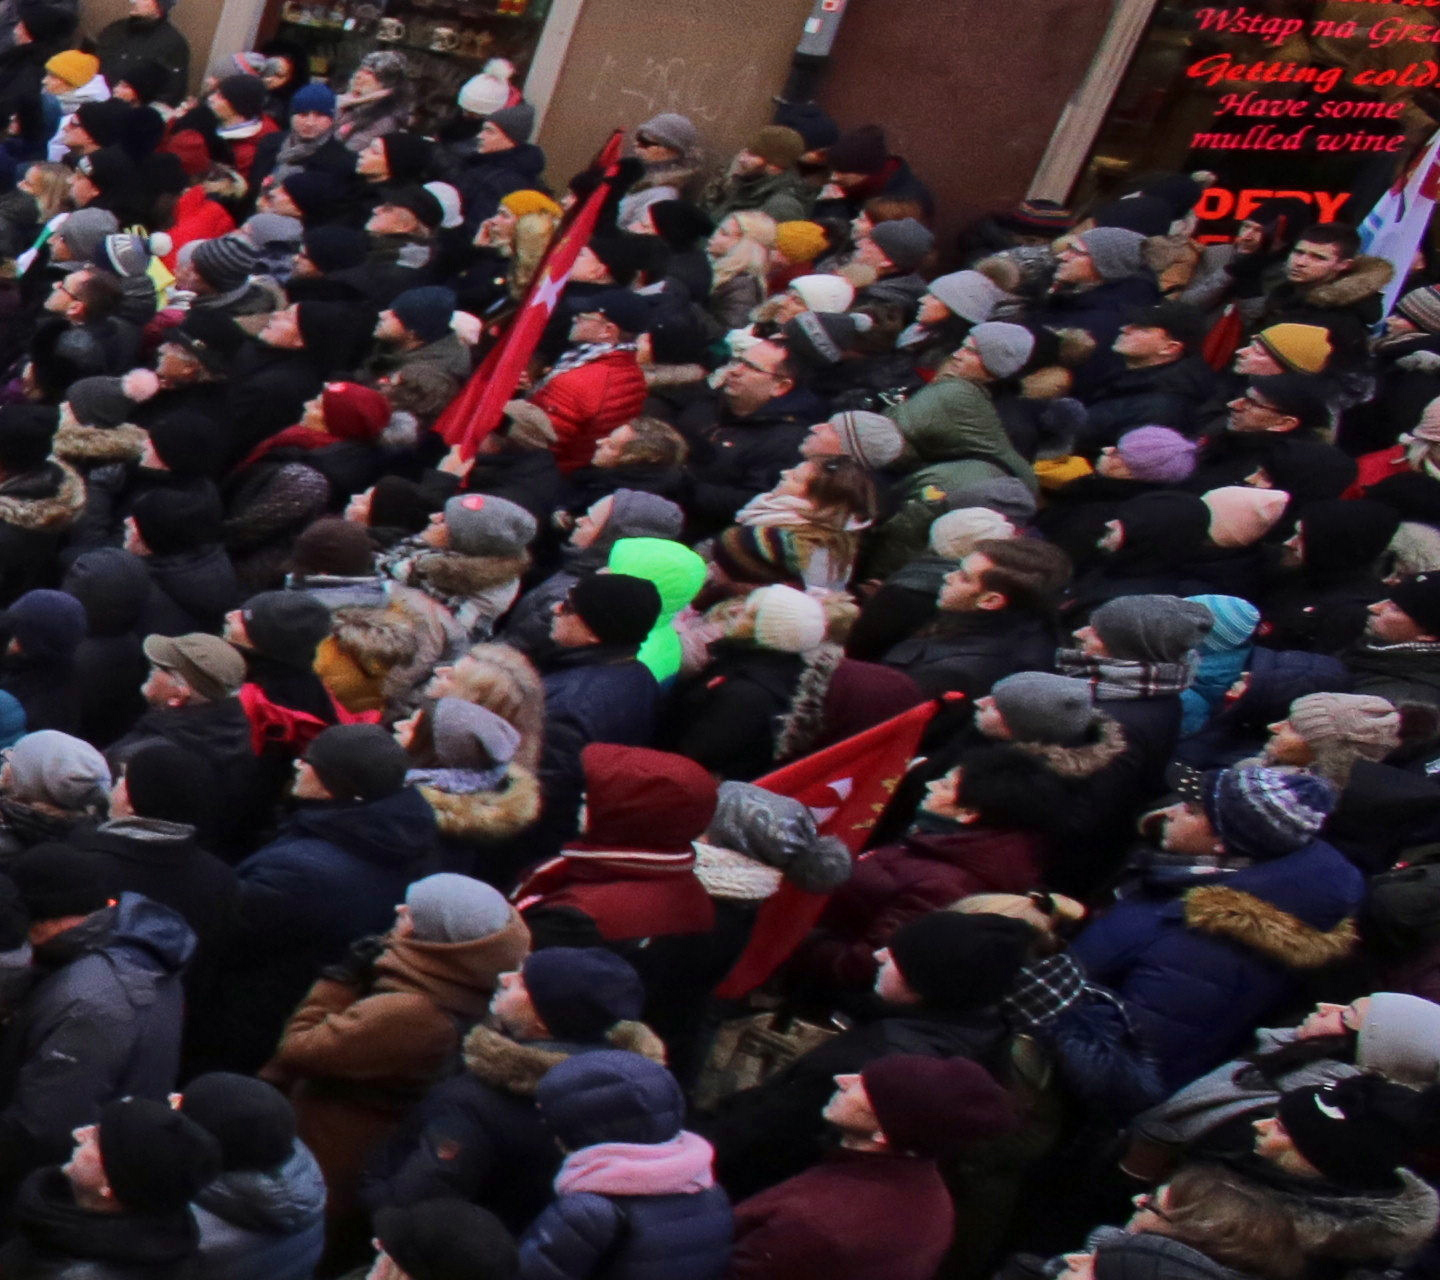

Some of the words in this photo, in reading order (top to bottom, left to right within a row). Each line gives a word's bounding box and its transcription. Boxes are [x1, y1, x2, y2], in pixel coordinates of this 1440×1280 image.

[1195, 7, 1303, 46] Wstąp
[1312, 19, 1357, 38] na
[1186, 53, 1344, 93] Getting
[1214, 91, 1308, 117] Have
[1315, 101, 1406, 119] some
[1190, 125, 1314, 150] mulled
[1315, 130, 1406, 152] wine
